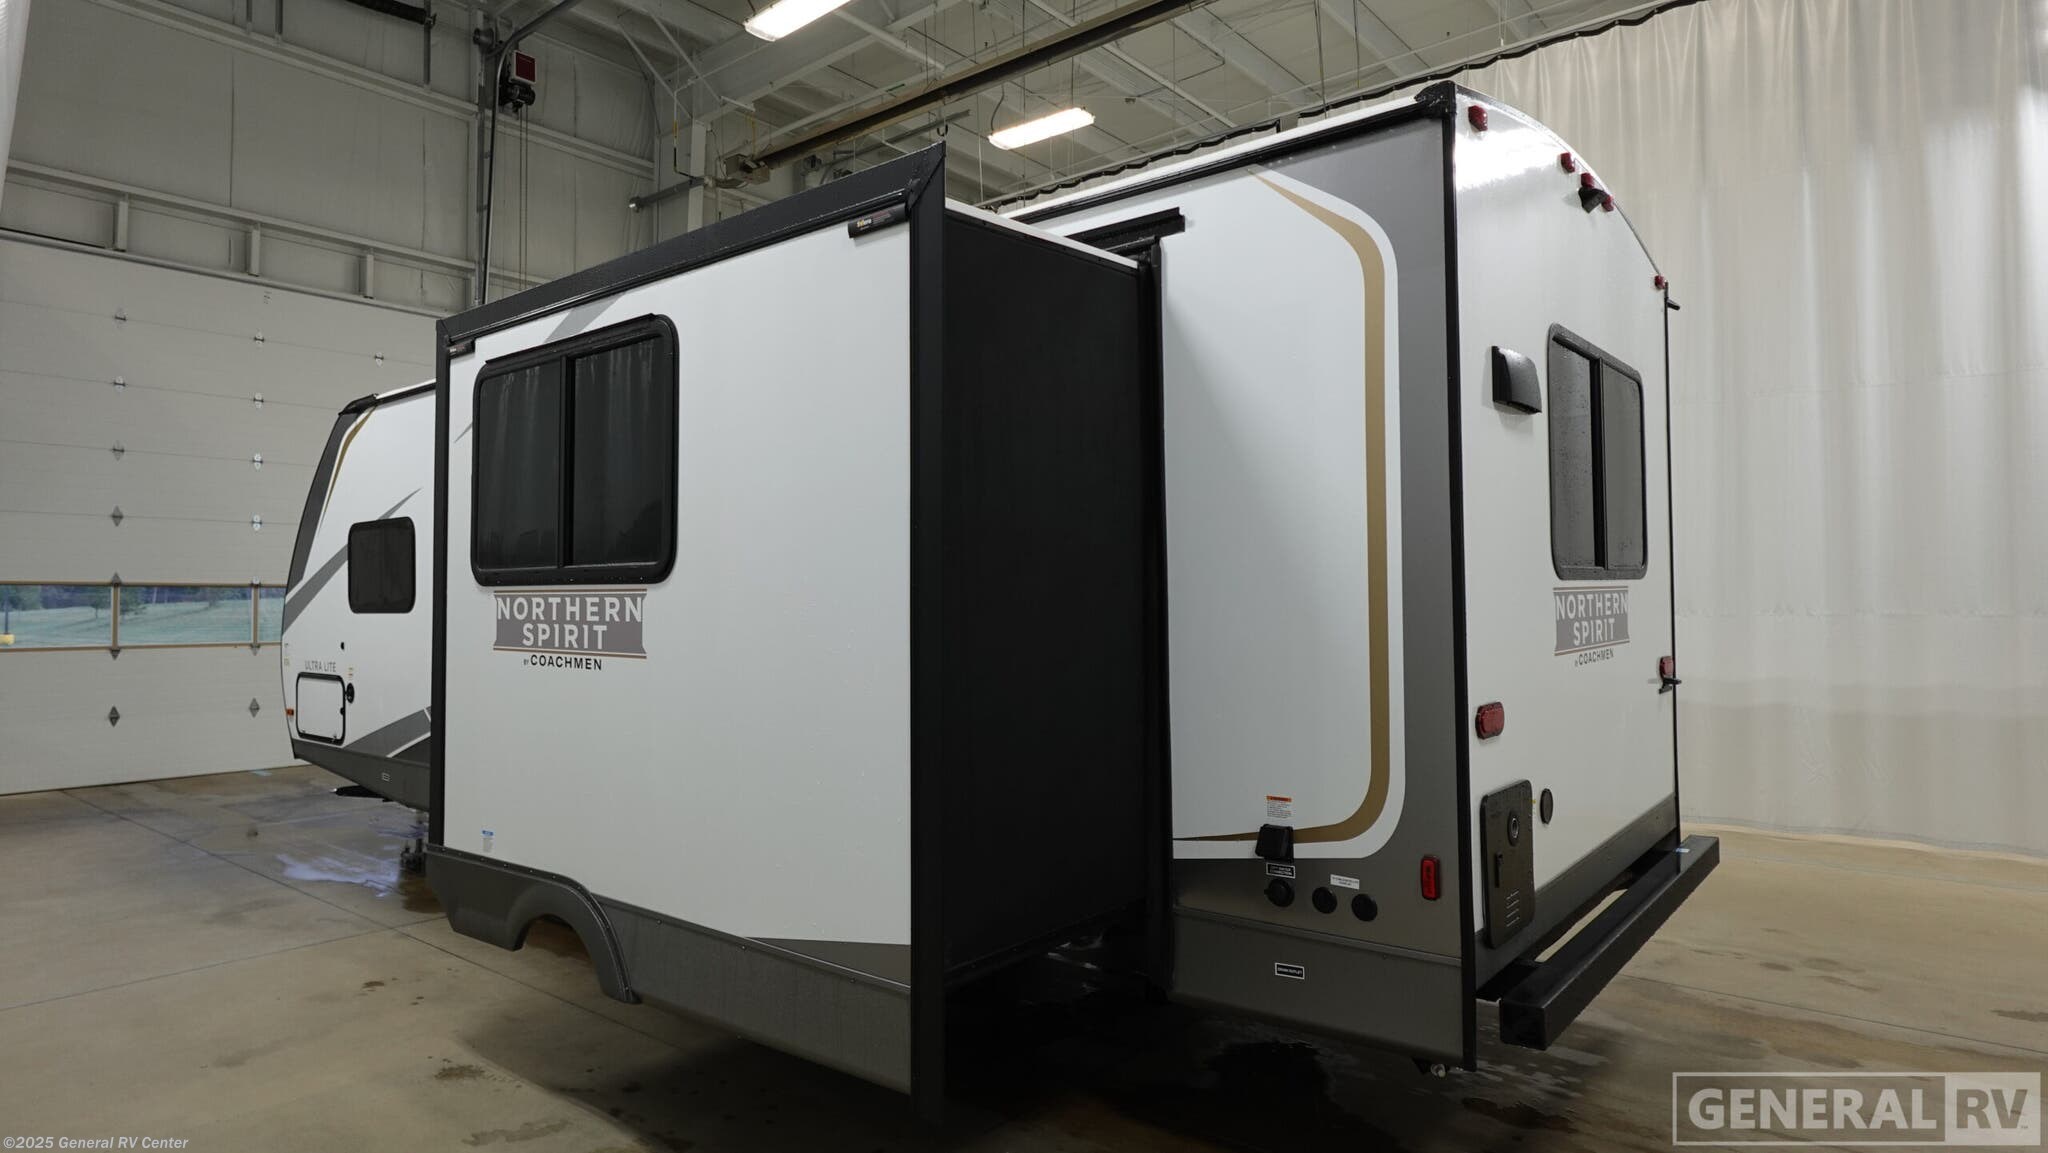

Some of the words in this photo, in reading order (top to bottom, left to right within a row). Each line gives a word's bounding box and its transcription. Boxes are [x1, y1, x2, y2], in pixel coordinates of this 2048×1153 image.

[497, 596, 642, 623] NORTHERN
[1555, 592, 1628, 621] NORTHERN
[522, 622, 608, 650] SPIRIT
[1573, 617, 1615, 646] SPIRIT
[304, 660, 323, 672] ULTRA
[324, 662, 336, 673] LITE
[530, 654, 602, 671] COACHMEN
[1578, 648, 1614, 666] COACHMEN
